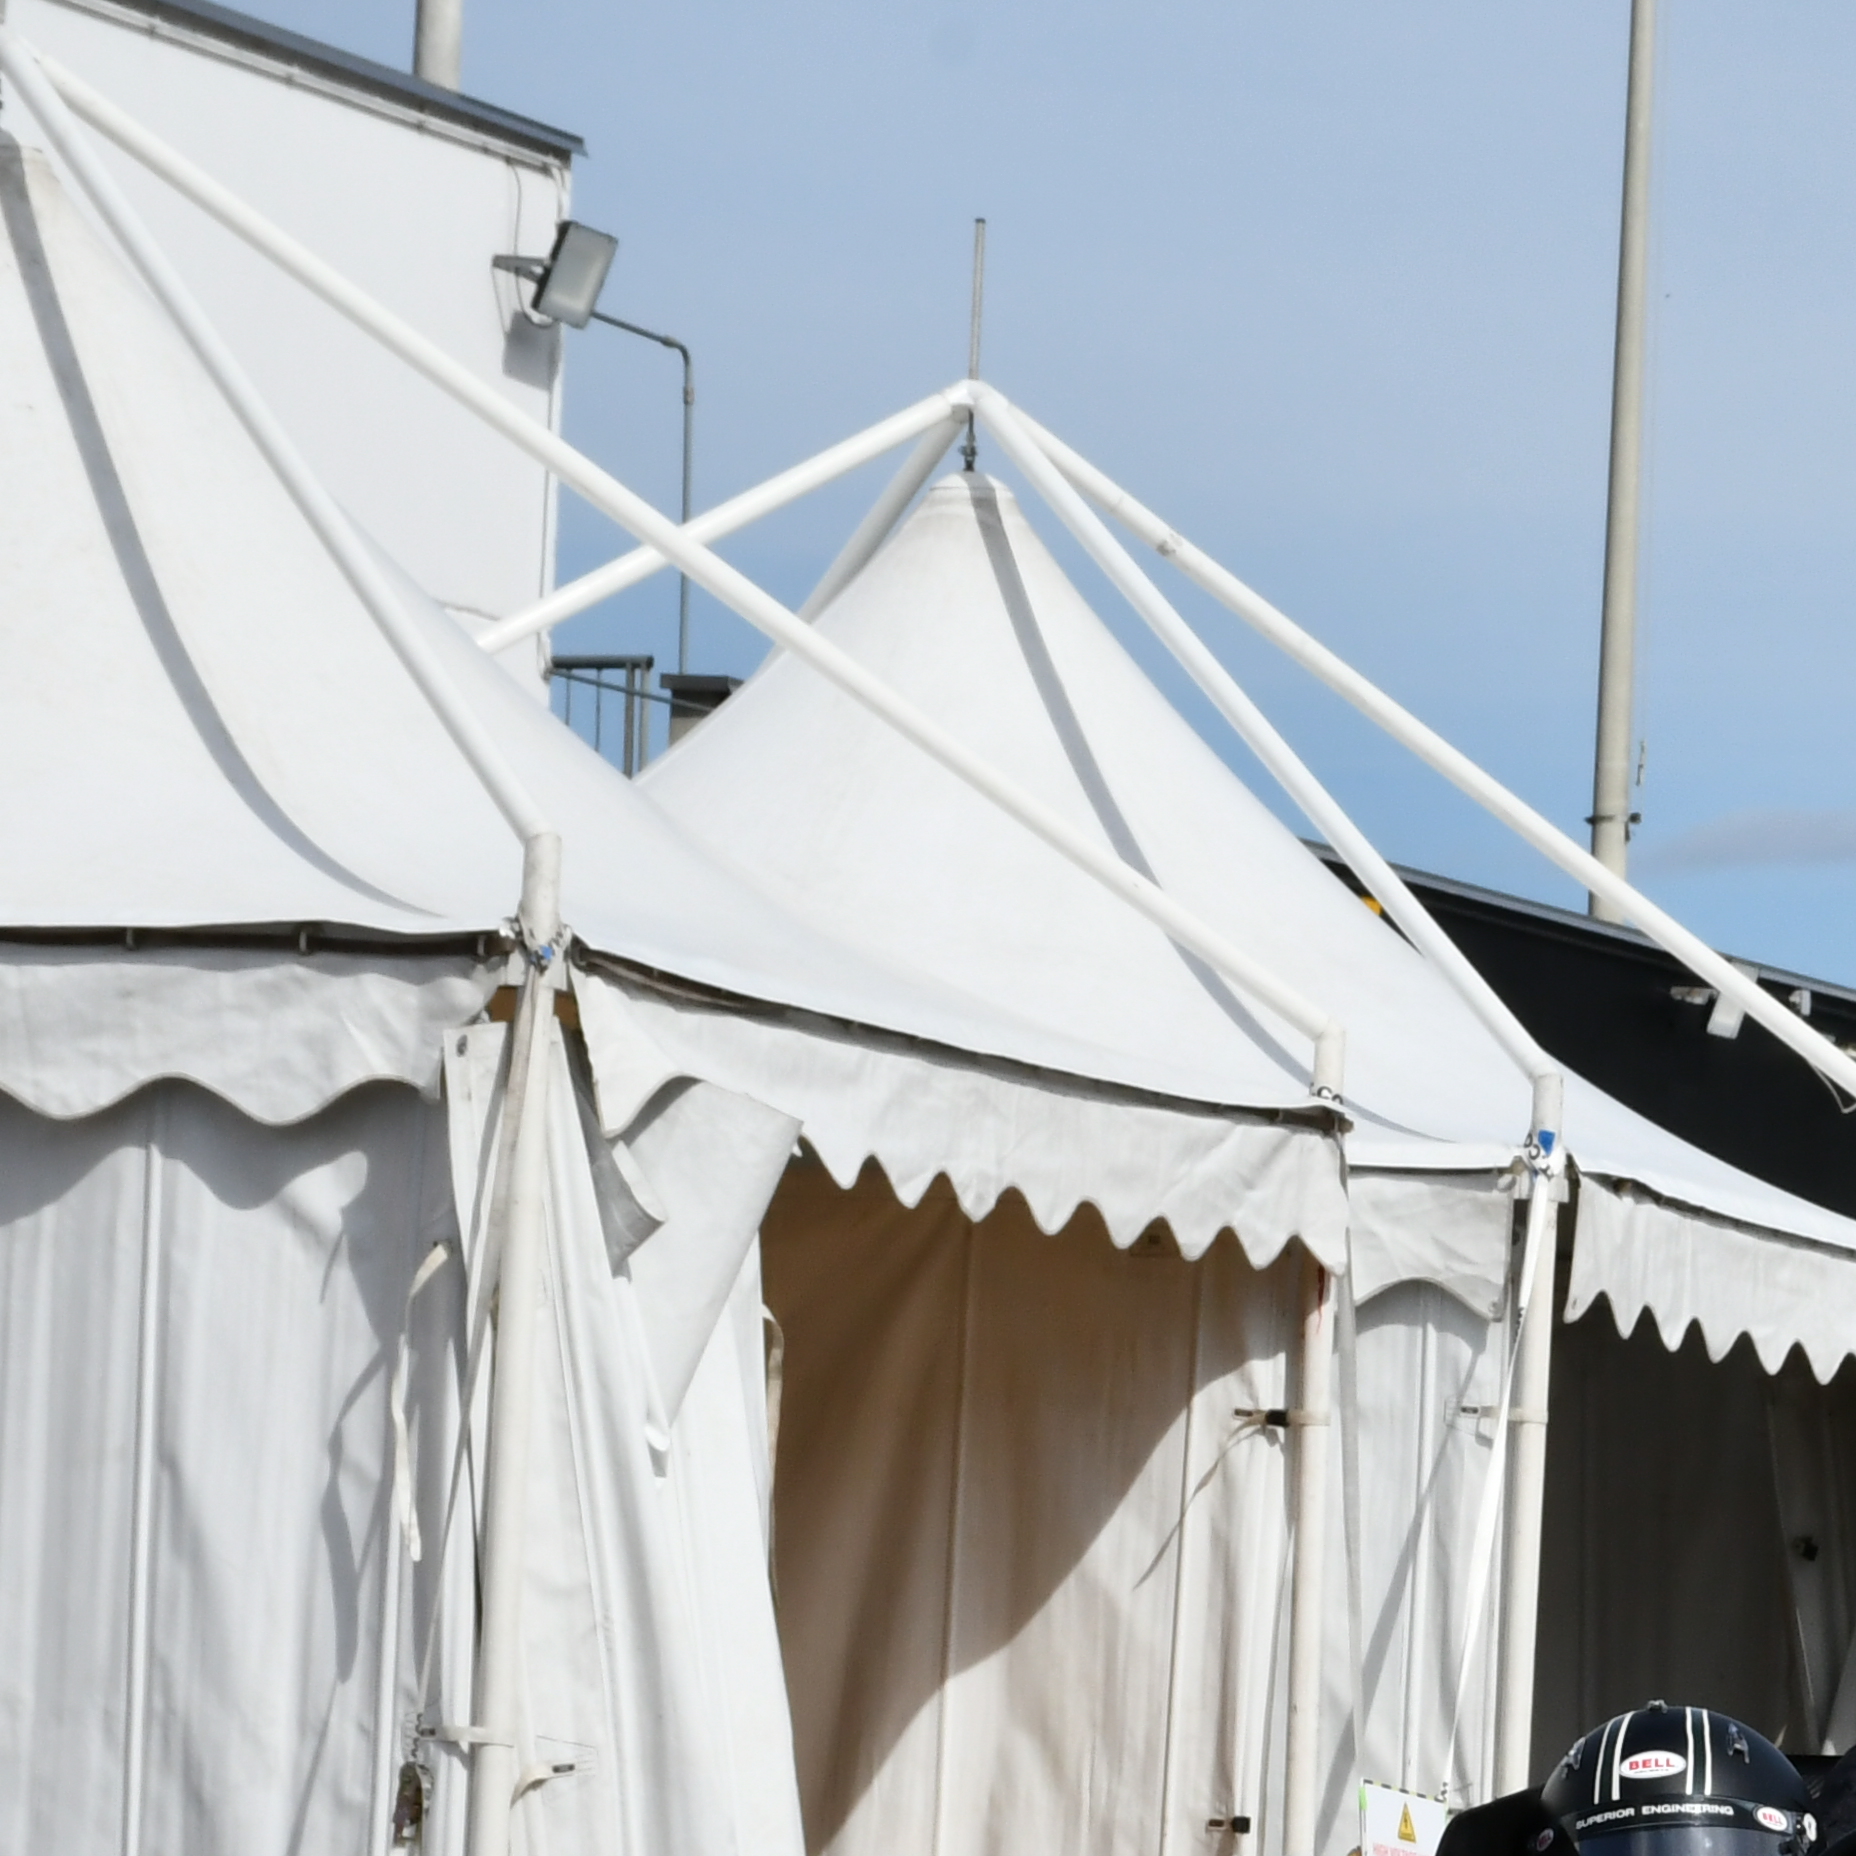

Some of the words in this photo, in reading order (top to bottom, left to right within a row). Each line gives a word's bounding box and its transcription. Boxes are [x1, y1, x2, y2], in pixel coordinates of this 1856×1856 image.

[1628, 1756, 1676, 1773] BELL
[1575, 1806, 1636, 1830] SUPERIOR
[1641, 1803, 1735, 1817] ENGINEERING
[1761, 1811, 1784, 1826] BELL
